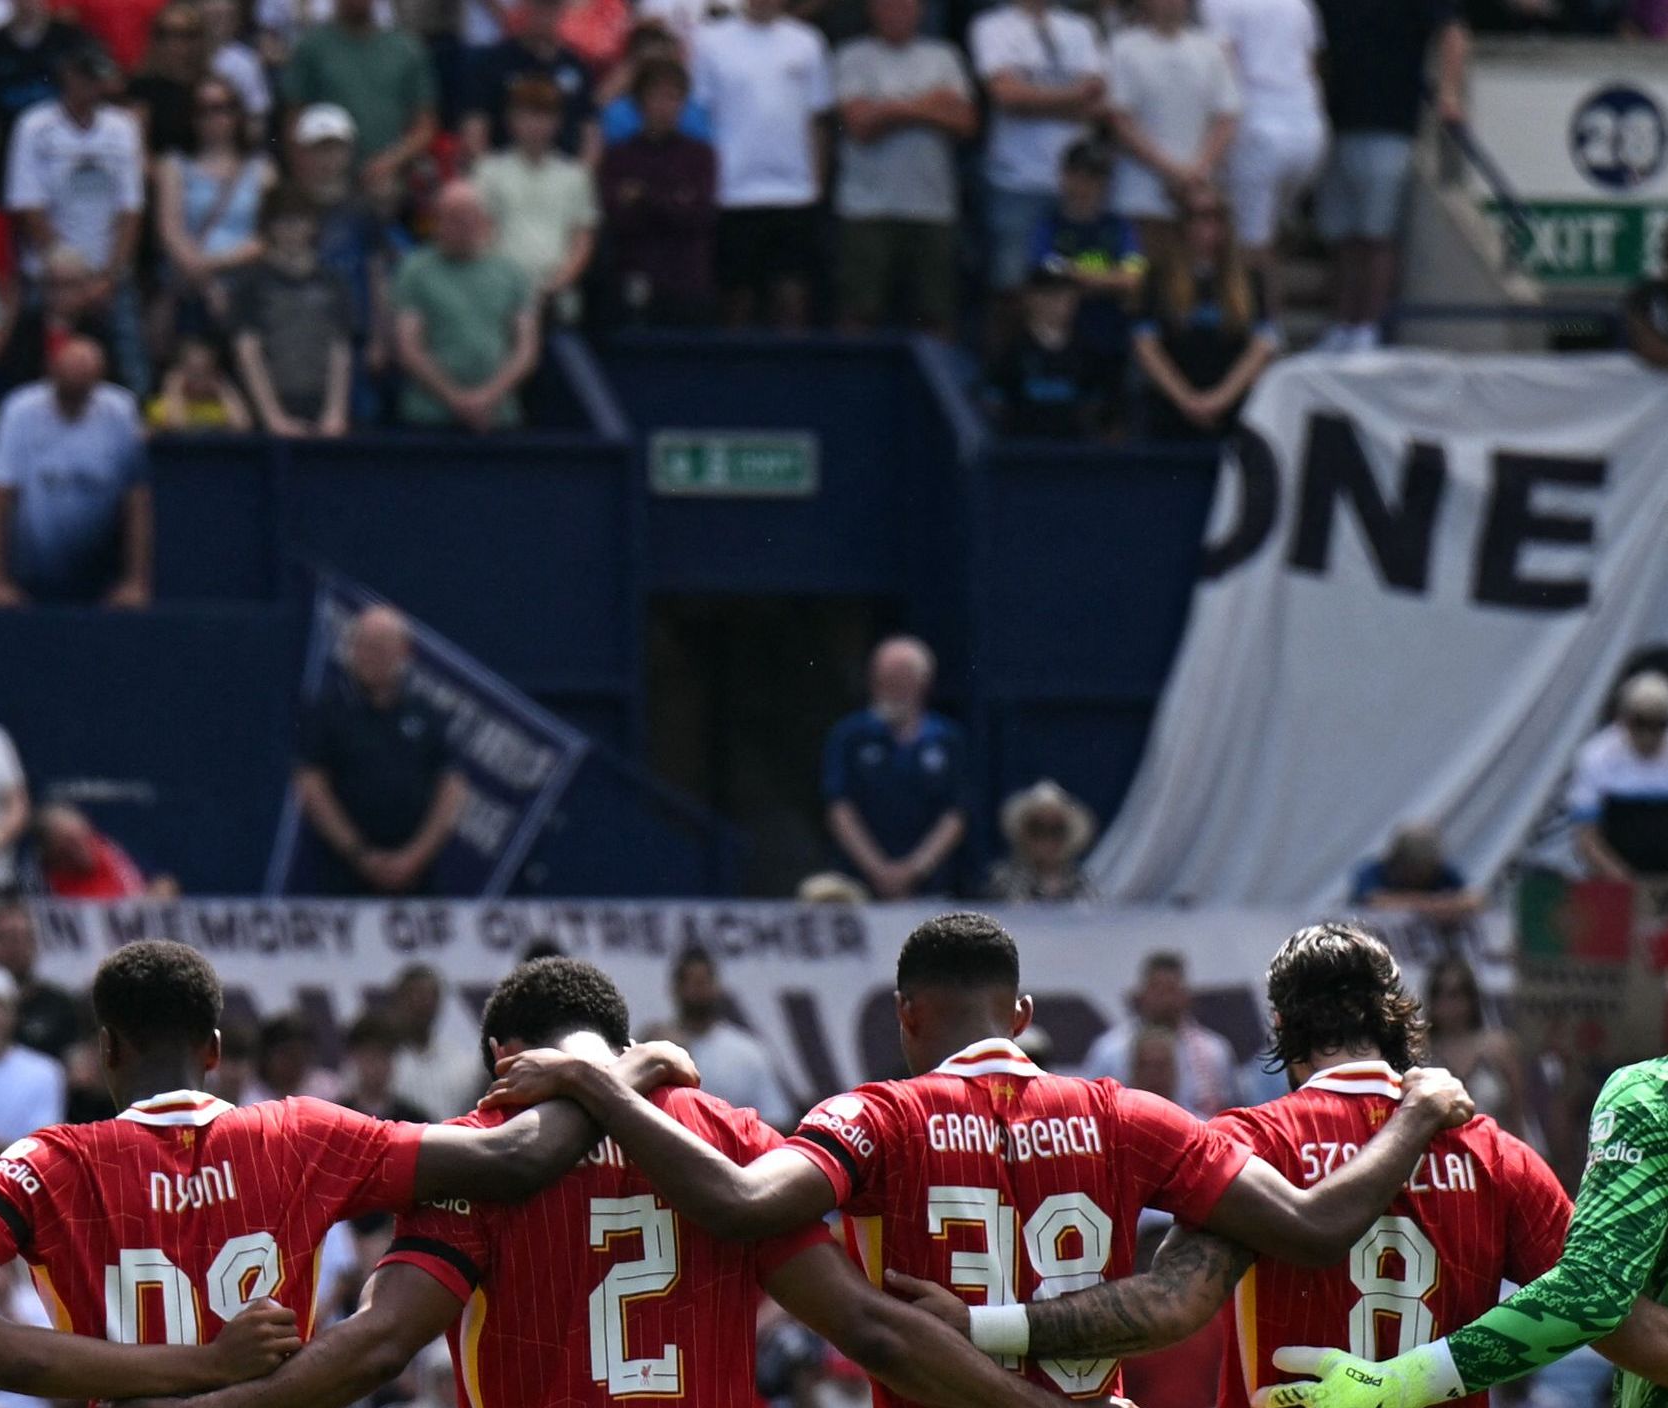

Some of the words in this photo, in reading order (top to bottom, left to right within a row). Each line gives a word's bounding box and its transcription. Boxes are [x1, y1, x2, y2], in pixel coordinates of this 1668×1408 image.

[1510, 211, 1618, 275] XIT
[928, 1113, 1103, 1164] GRAVBERCH
[589, 1194, 685, 1399] 2
[1349, 1215, 1441, 1362] 8
